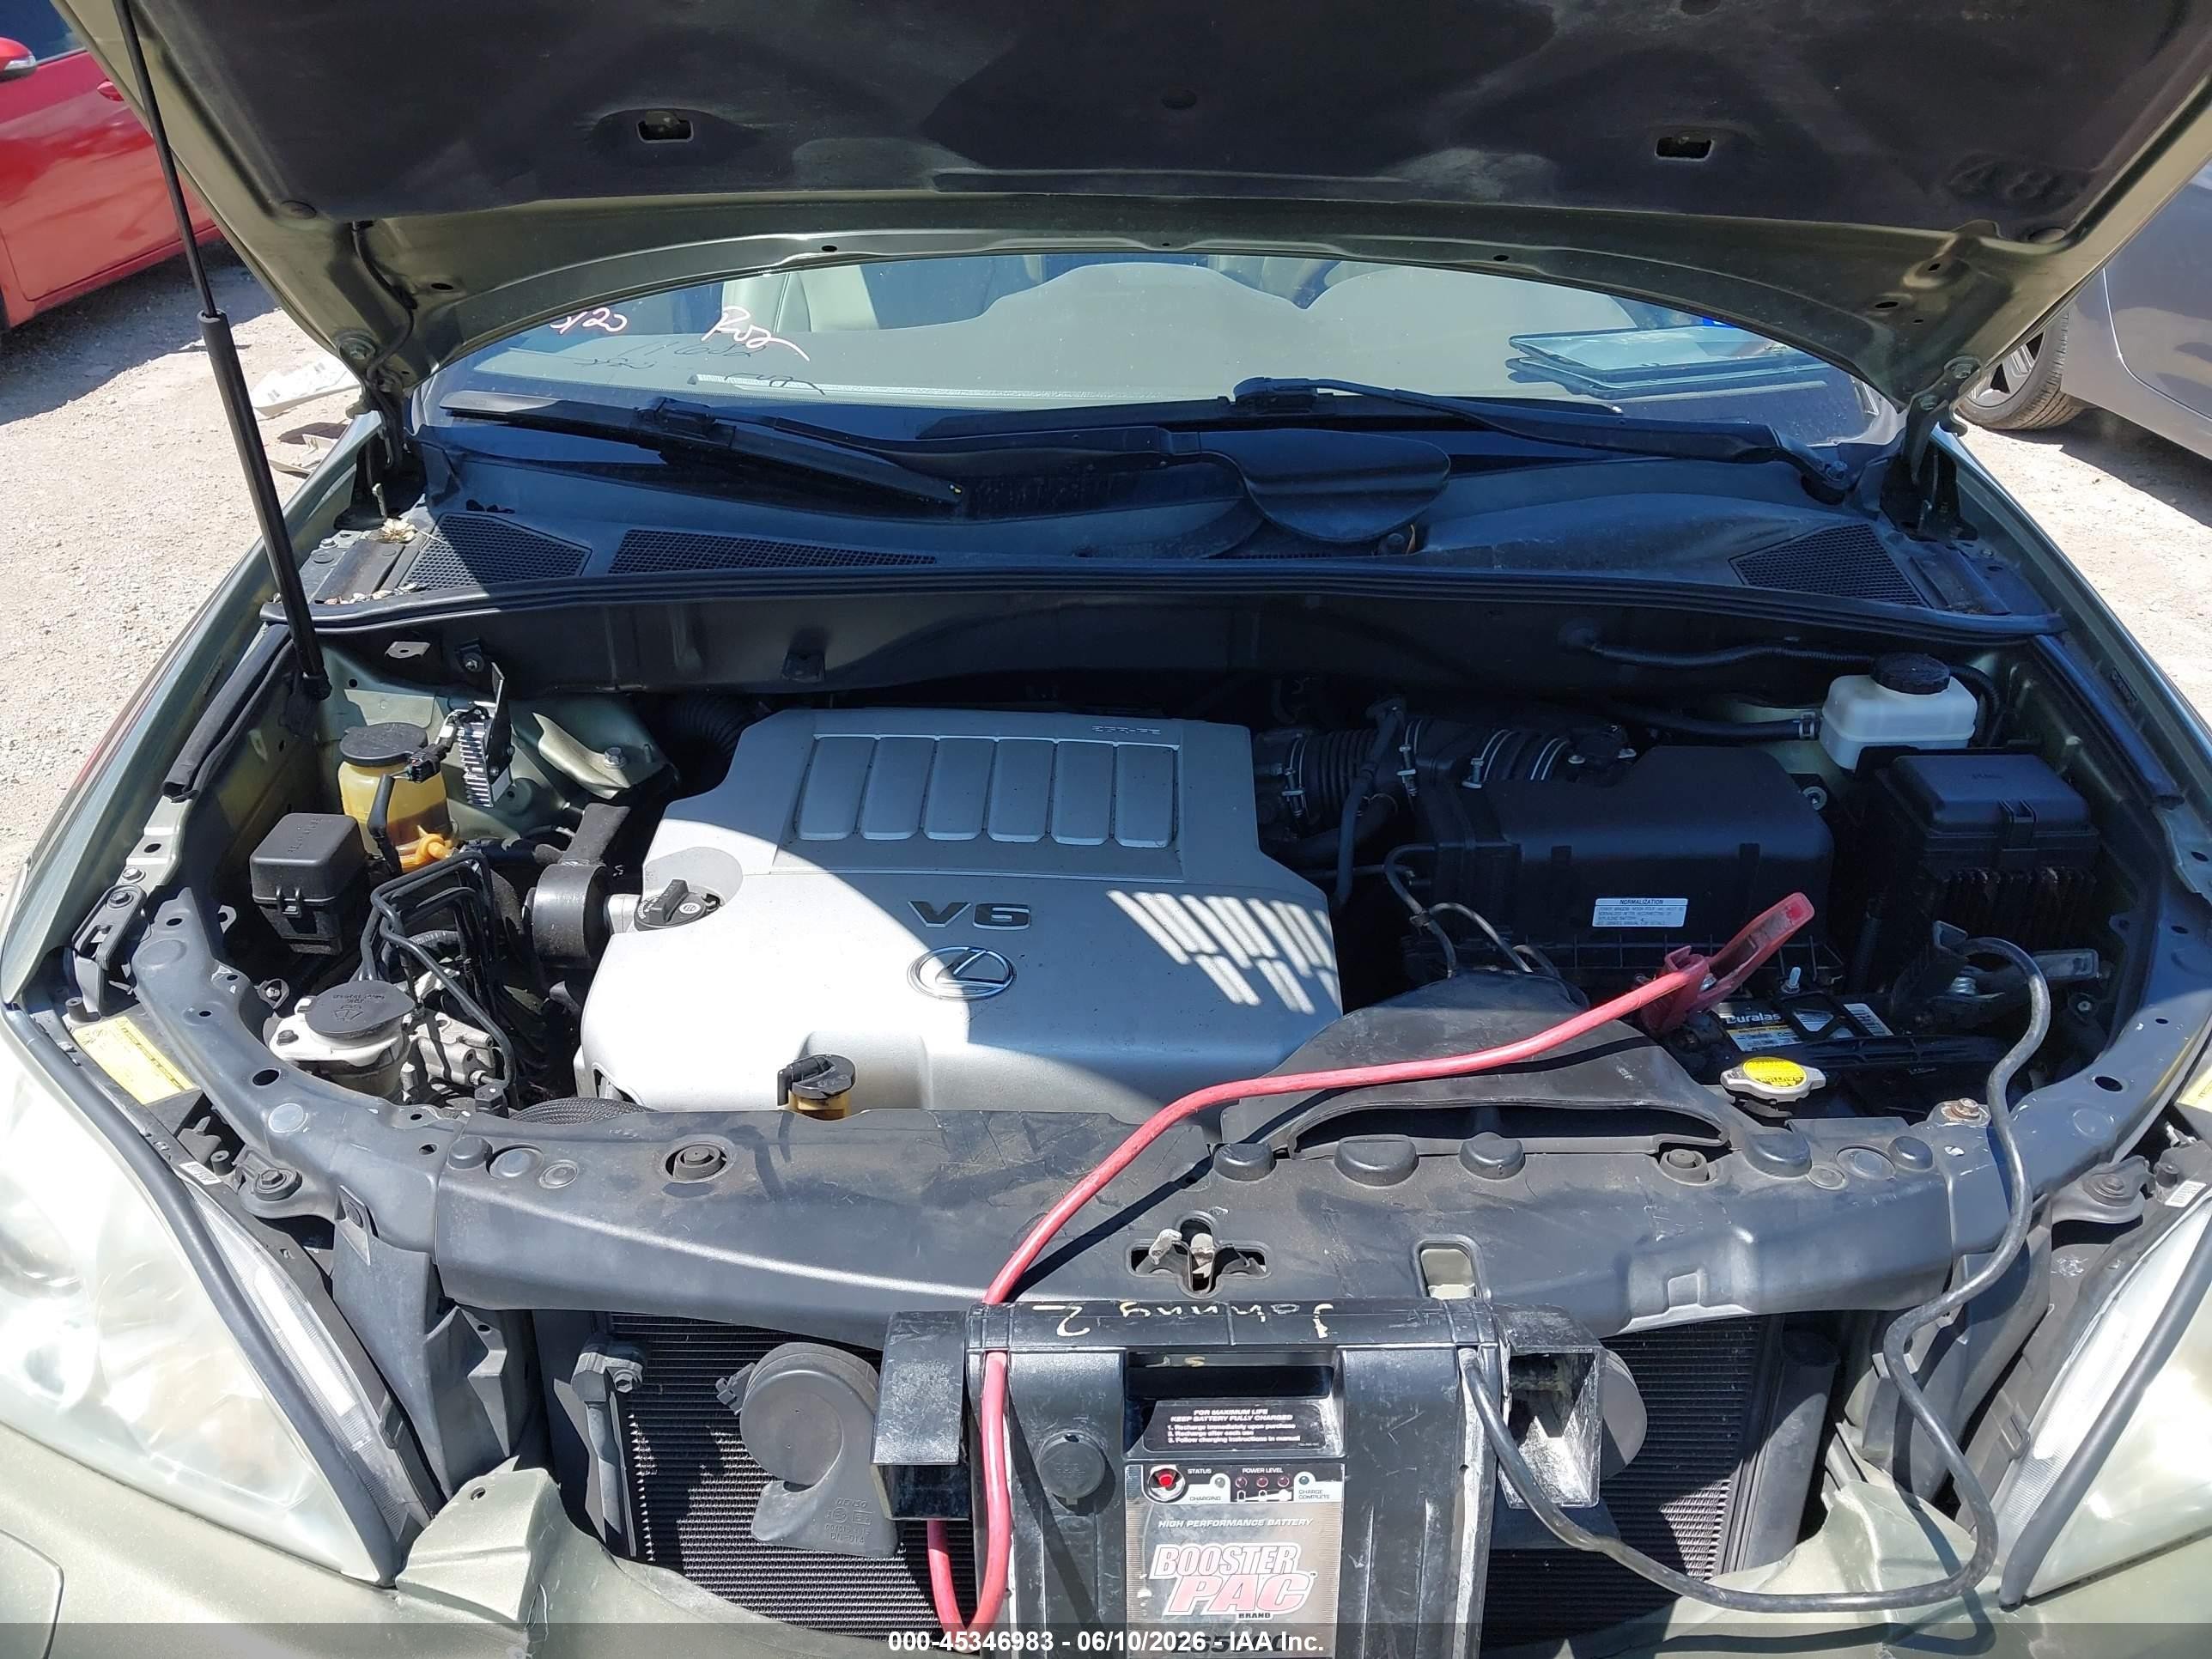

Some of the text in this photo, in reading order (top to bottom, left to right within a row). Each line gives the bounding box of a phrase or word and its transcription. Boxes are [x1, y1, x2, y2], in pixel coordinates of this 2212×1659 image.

[908, 900, 1031, 931] V6
[1032, 1301, 1334, 1338] Johnny 2
[1186, 1519, 1265, 1528] PERFORMANCE
[1152, 1544, 1299, 1577] BOOSTER
[1166, 1572, 1311, 1613] PAC
